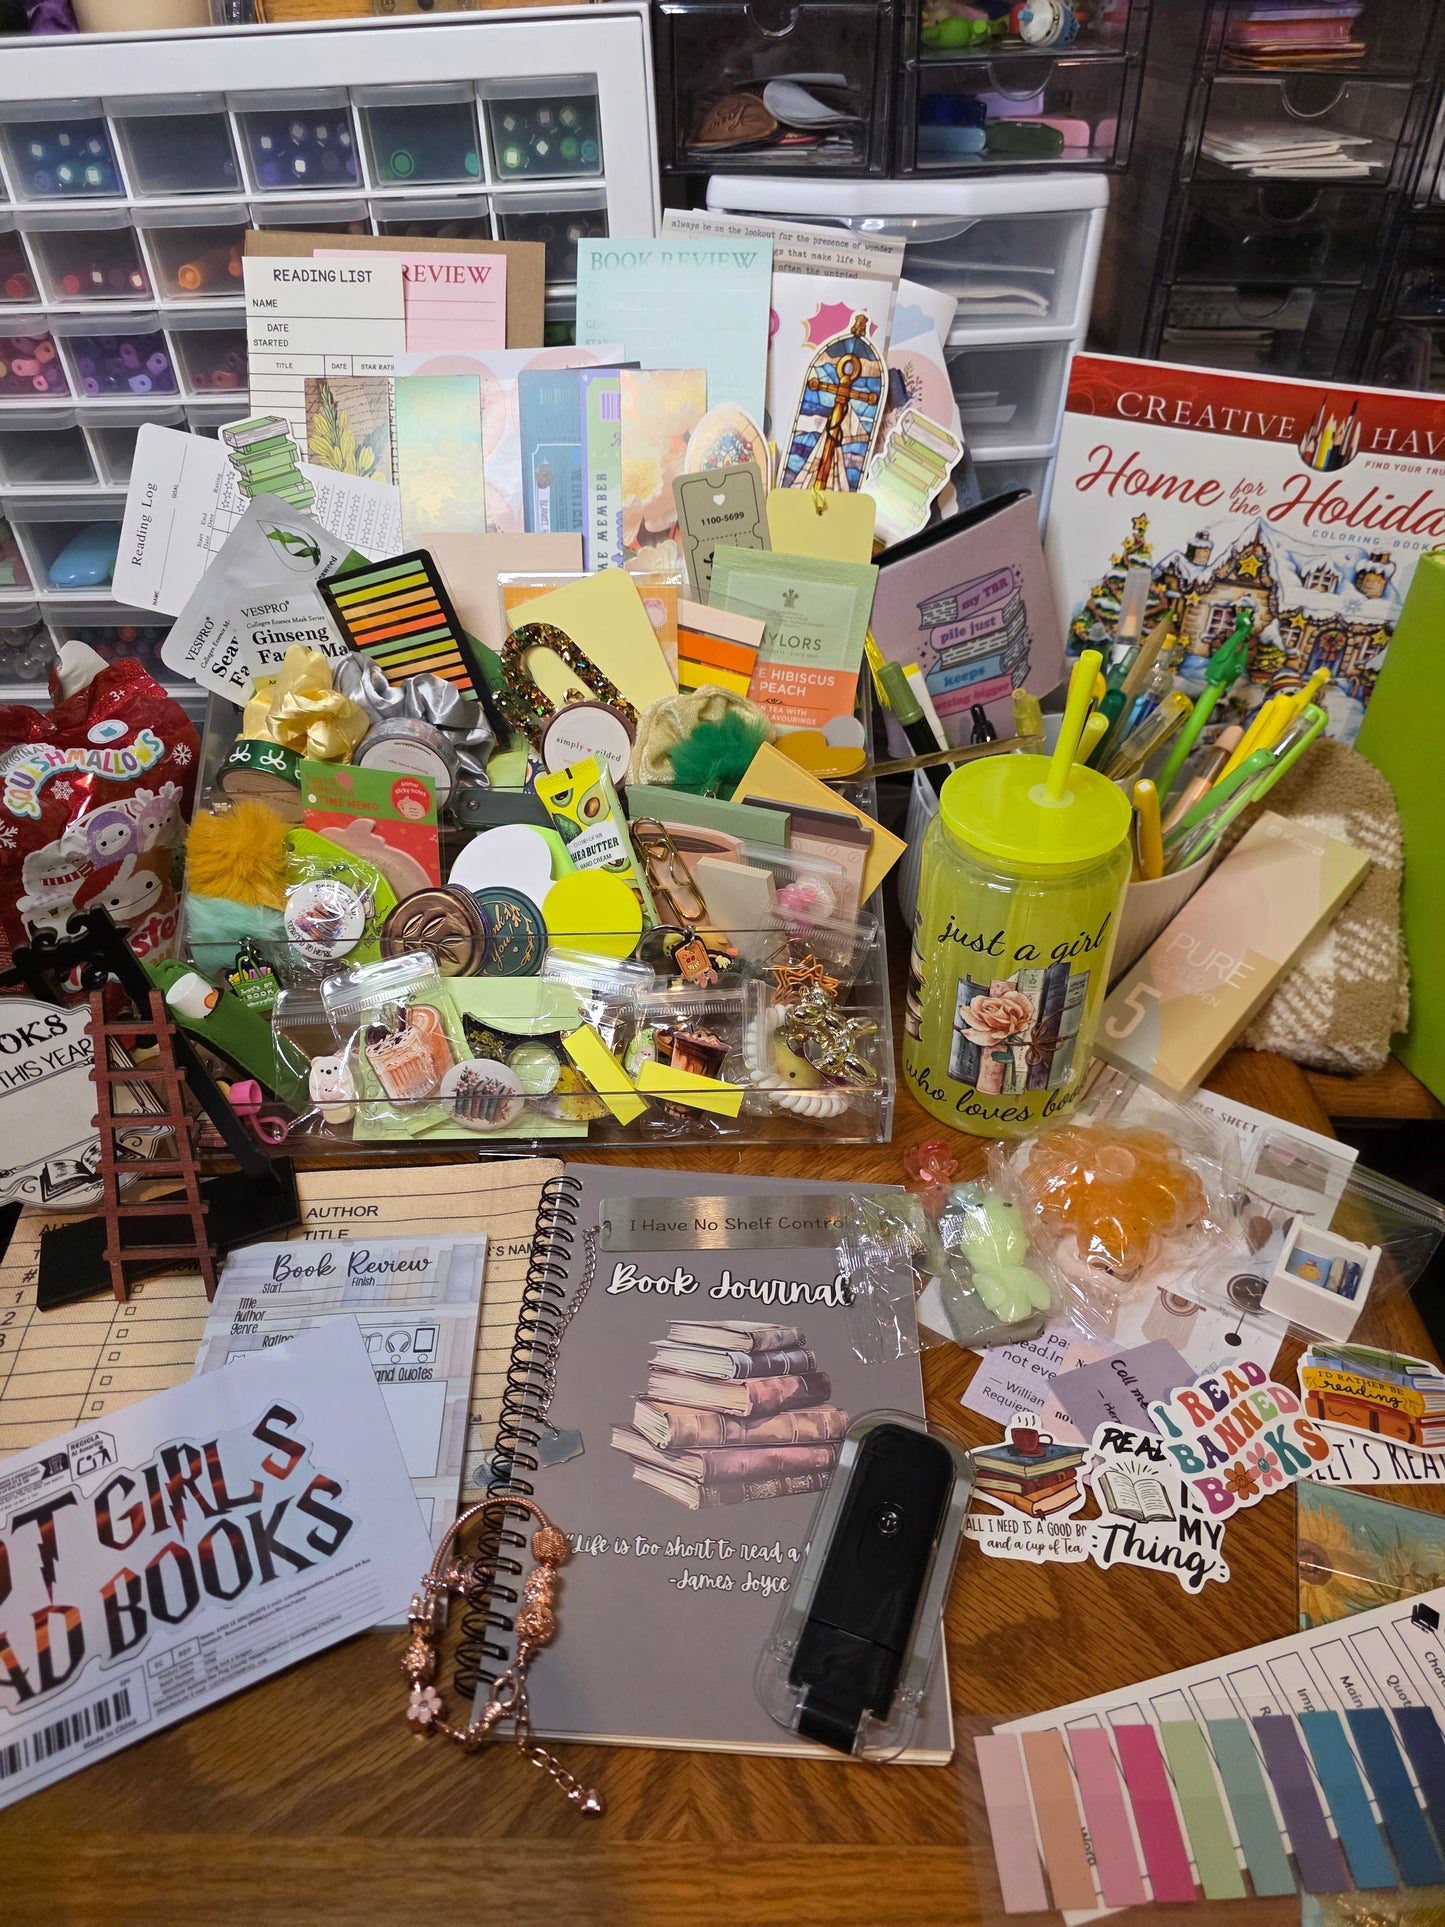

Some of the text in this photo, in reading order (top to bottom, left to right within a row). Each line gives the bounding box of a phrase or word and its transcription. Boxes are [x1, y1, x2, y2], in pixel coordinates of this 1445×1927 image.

[672, 220, 894, 253] always be on the lookout for the presence of wonder
[590, 251, 652, 271] BOOK
[788, 249, 807, 259] that
[811, 252, 831, 262] make
[837, 254, 854, 264] life
[857, 257, 872, 268] big
[273, 268, 372, 283] READING LIST
[778, 263, 801, 273] often
[806, 266, 820, 275] the
[252, 299, 278, 308] NAME
[267, 323, 289, 333] DATE
[253, 338, 289, 348] STARTED
[1117, 392, 1296, 440] CREATIVE
[1370, 427, 1445, 456] HAV
[1364, 461, 1445, 476] FIND YOUR TRU
[171, 483, 180, 499] GOAL
[1075, 445, 1445, 538] Home for the Holida
[596, 473, 609, 541] MEMBER
[131, 482, 158, 566] Reading Log
[701, 511, 745, 526] 1100-5699
[1312, 529, 1430, 551] COLORING BOOK
[152, 590, 160, 606] NAME
[961, 576, 1009, 610] my TBR
[247, 614, 325, 629] Collagen Essence Mask Series
[940, 616, 996, 645] pile just
[252, 626, 329, 646] Ginseng
[201, 648, 215, 669] Collagen
[213, 630, 227, 649] Essence
[771, 669, 835, 687] HIBISCUS
[944, 665, 985, 688] keeps
[110, 689, 126, 702] 3+
[759, 681, 806, 696] PEACH
[769, 705, 807, 716] TEA WITH
[556, 737, 584, 752] simply
[410, 788, 427, 797] notes
[580, 853, 613, 870] HAND CREAM
[937, 911, 1112, 969] just a girl
[1165, 931, 1256, 989] PURE
[246, 989, 274, 1000] BOOK
[1104, 982, 1162, 1039] 5
[0, 1013, 68, 1055] OKS
[0, 1037, 95, 1090] THIS YEAR
[905, 1058, 1035, 1122] who loves
[1221, 1112, 1259, 1133] SHEET
[306, 1205, 379, 1219] AUTHOR
[630, 1217, 773, 1232] I Have No Shelf
[303, 1229, 349, 1241] TITLE
[273, 1250, 433, 1281] Book Review
[21, 1269, 38, 1283] #
[351, 1276, 375, 1287] Finish
[606, 1262, 855, 1307] Book Journal
[15, 1290, 24, 1304] 1
[262, 1282, 282, 1294] Start
[239, 1297, 257, 1310] Title
[2, 1311, 16, 1326] 2
[233, 1310, 266, 1322] Author
[1002, 1350, 1029, 1368] not
[375, 1366, 433, 1383] and Quotes
[1110, 1358, 1139, 1387] Call
[1130, 1386, 1150, 1410] me
[1337, 1372, 1386, 1391] RATHER
[1390, 1384, 1405, 1395] BE
[1153, 1405, 1183, 1439] I
[1177, 1361, 1267, 1428] READ
[1318, 1378, 1403, 1409] reading
[1167, 1386, 1299, 1474] BANNED
[70, 1434, 100, 1451] RECICLA
[94, 1403, 307, 1551] GIRLS
[966, 1518, 1072, 1537] ALL I NEED IS A GOOD
[1179, 1515, 1222, 1550] MY
[614, 1535, 801, 1564] is too short to read a
[987, 1536, 1012, 1551] and
[1014, 1541, 1023, 1550] a
[1048, 1539, 1062, 1555] of
[1061, 1538, 1083, 1554] Tea
[1097, 1522, 1216, 1588] Thing
[100, 1474, 354, 1660] BOOKS
[740, 1571, 791, 1599] Joyce
[1339, 1675, 1364, 1708] Main
[1386, 1674, 1413, 1709] Quot
